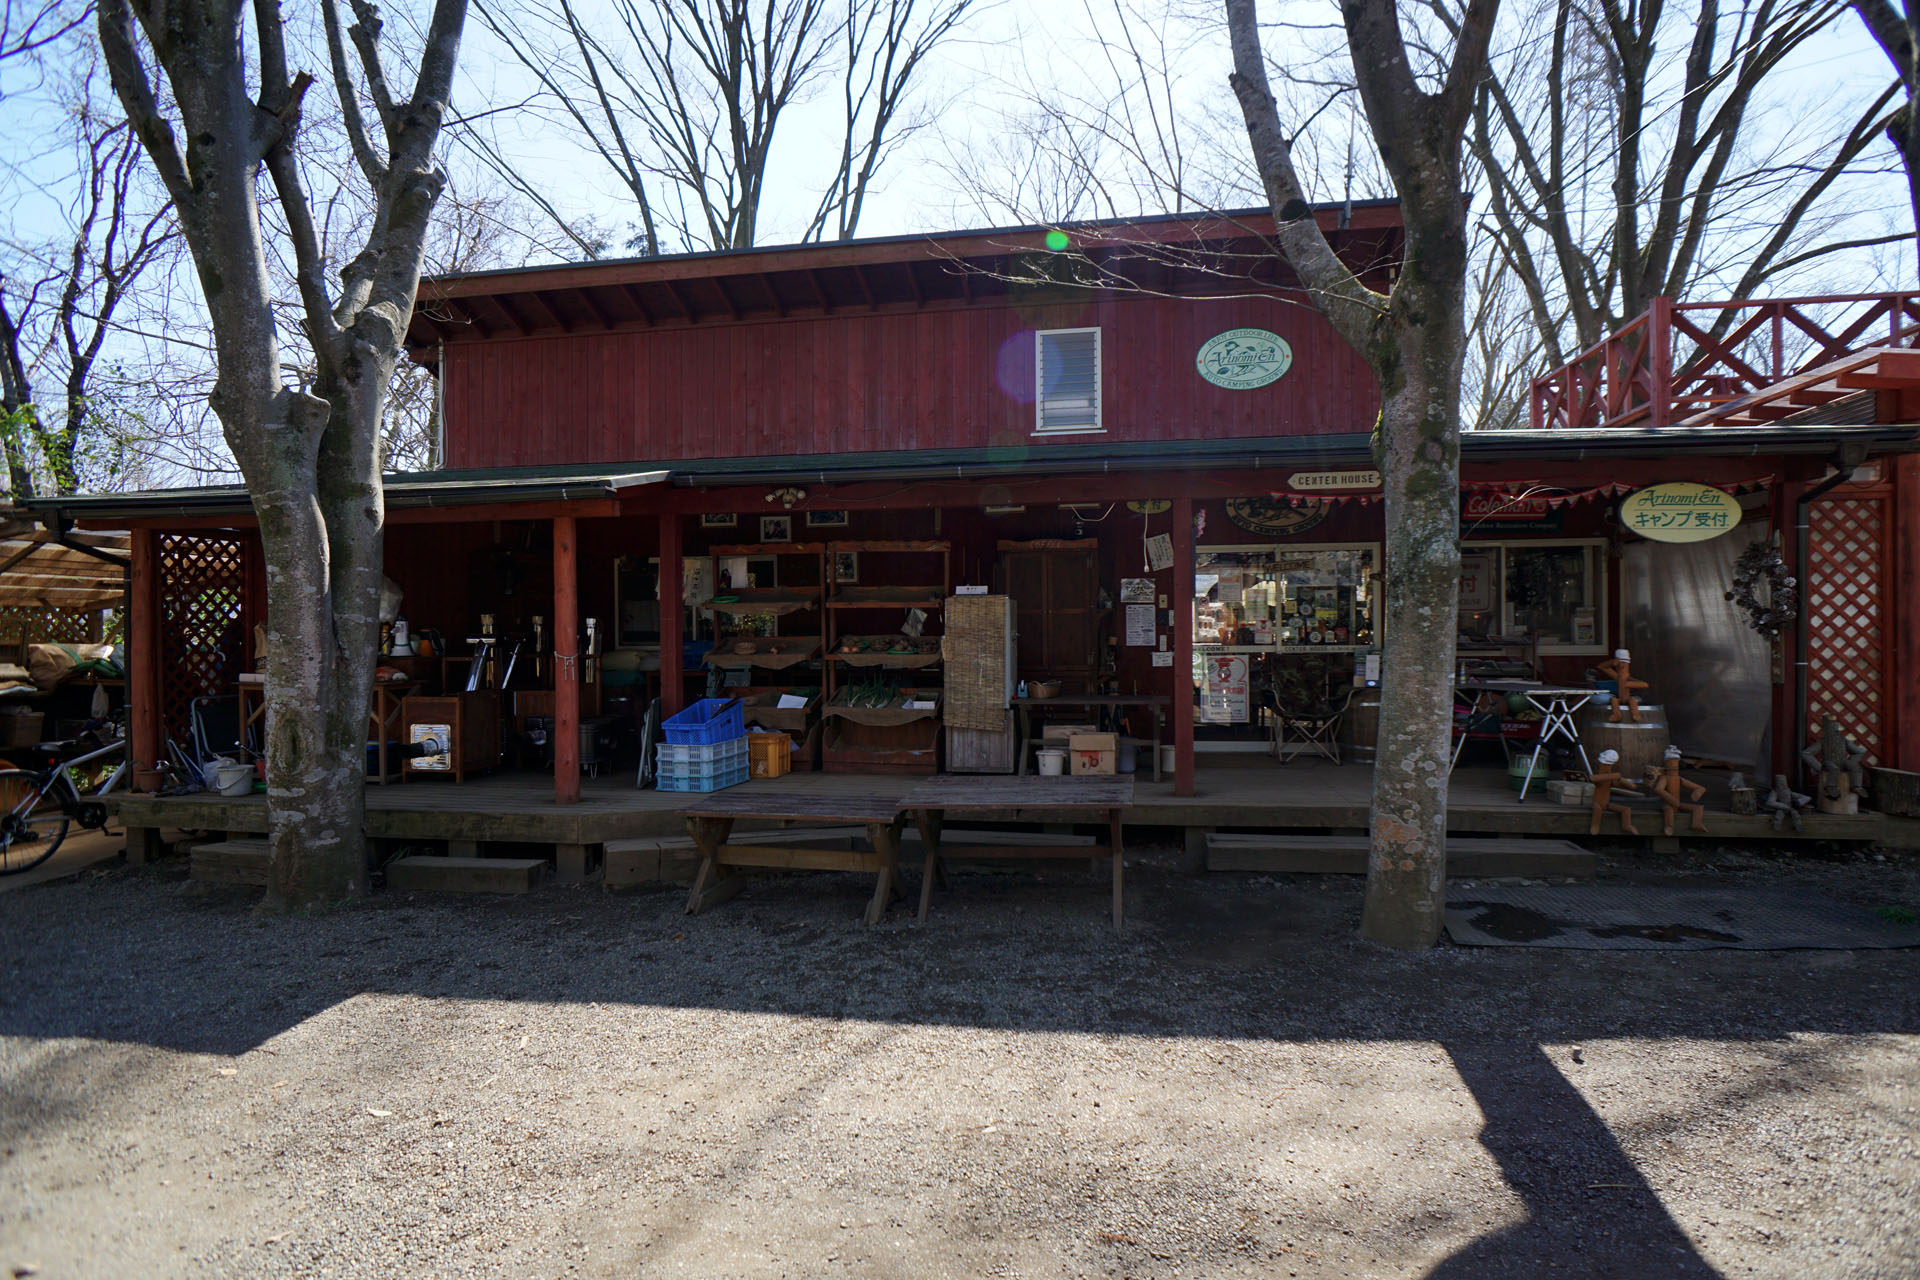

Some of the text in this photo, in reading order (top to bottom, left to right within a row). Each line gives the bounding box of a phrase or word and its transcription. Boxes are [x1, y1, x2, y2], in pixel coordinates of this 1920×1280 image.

[1229, 330, 1263, 338] OUTDOOR
[1263, 331, 1278, 342] LIFE
[1204, 368, 1284, 388] AUTO CAMPING GROUND
[1298, 474, 1374, 486] CENTER HOUSE
[1638, 490, 1698, 508] Arinomi
[1635, 510, 1729, 527] キャンプ受付
[1264, 560, 1311, 573] WELCOME
